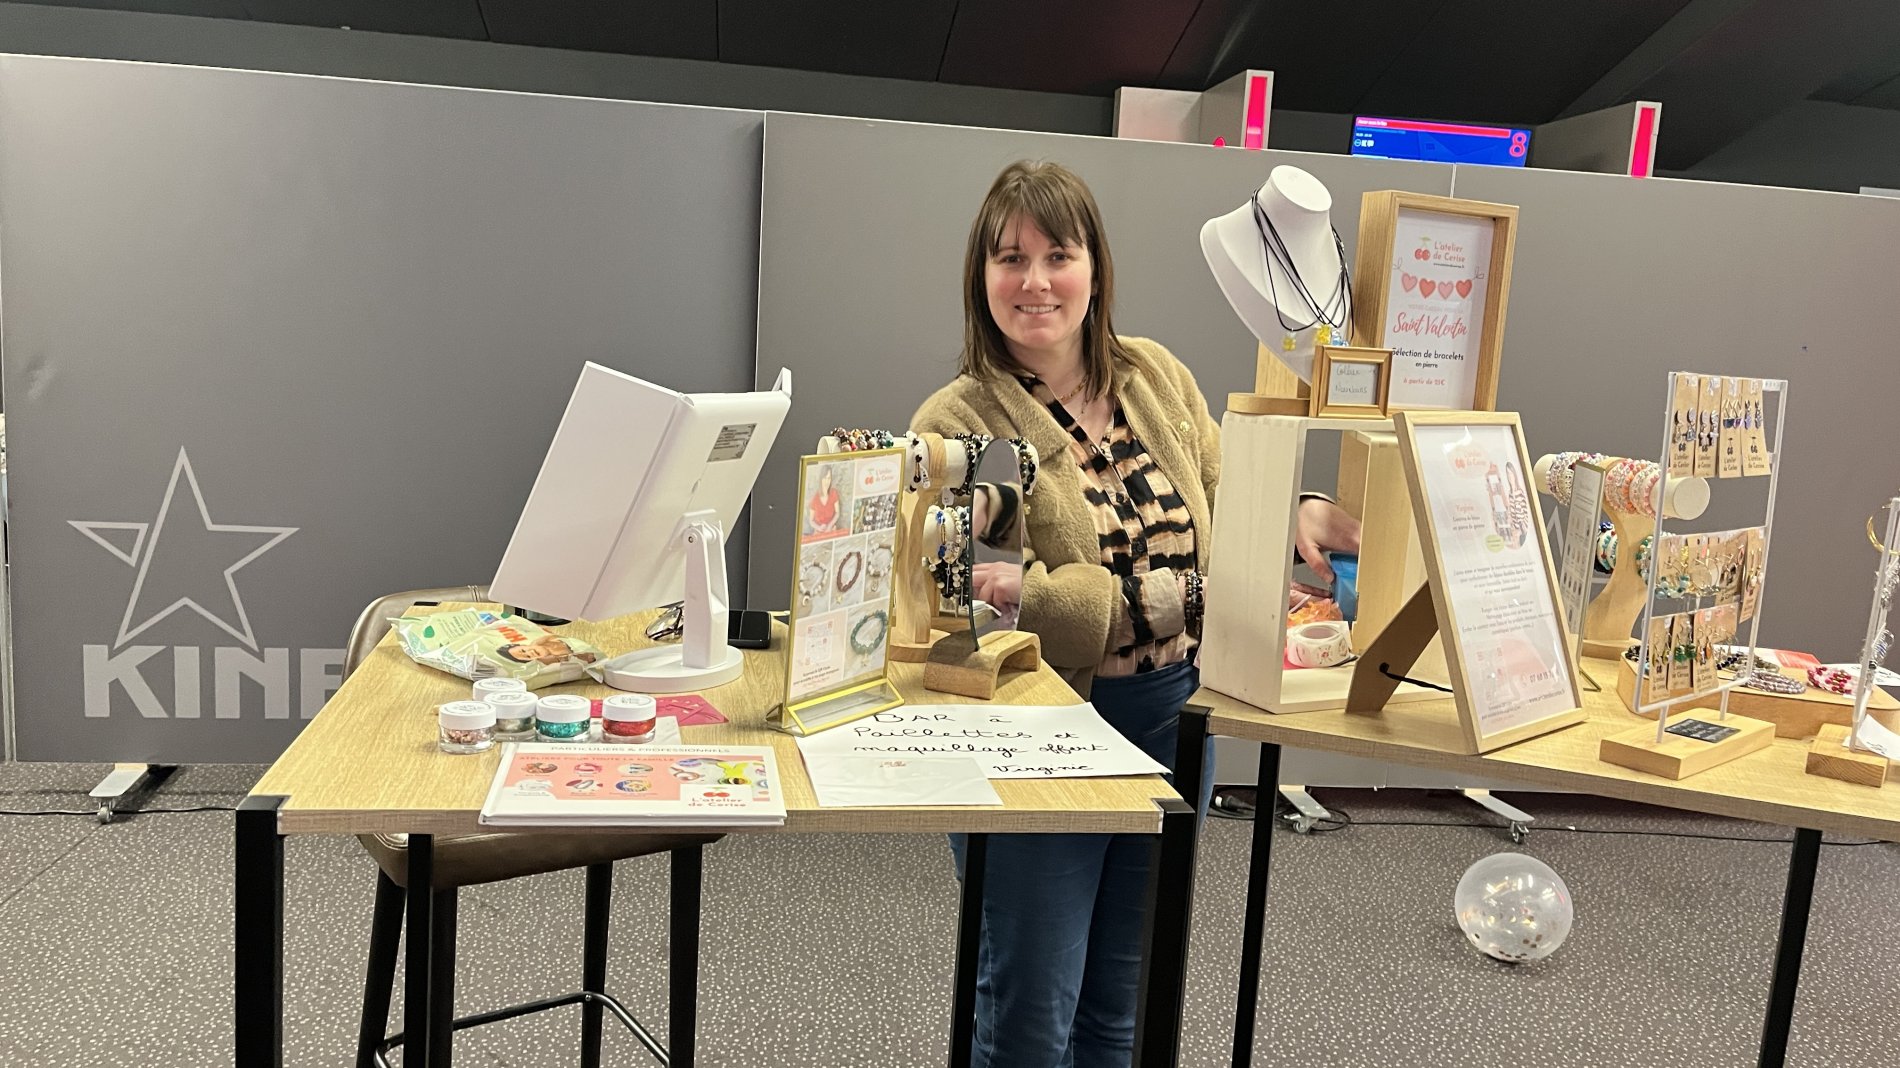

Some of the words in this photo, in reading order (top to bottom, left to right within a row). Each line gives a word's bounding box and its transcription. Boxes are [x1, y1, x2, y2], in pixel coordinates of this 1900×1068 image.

[1508, 131, 1527, 158] 8
[1434, 242, 1463, 253] L'atelier
[1444, 254, 1466, 262] Cerise
[1393, 312, 1426, 336] Saint
[1425, 314, 1468, 339] Valentin
[1423, 349, 1432, 358] de
[1434, 350, 1464, 360] bracelets
[873, 713, 956, 723] BAR
[854, 743, 1028, 758] maquillage
[1039, 743, 1108, 754] offert
[993, 764, 1094, 775] Virginie
